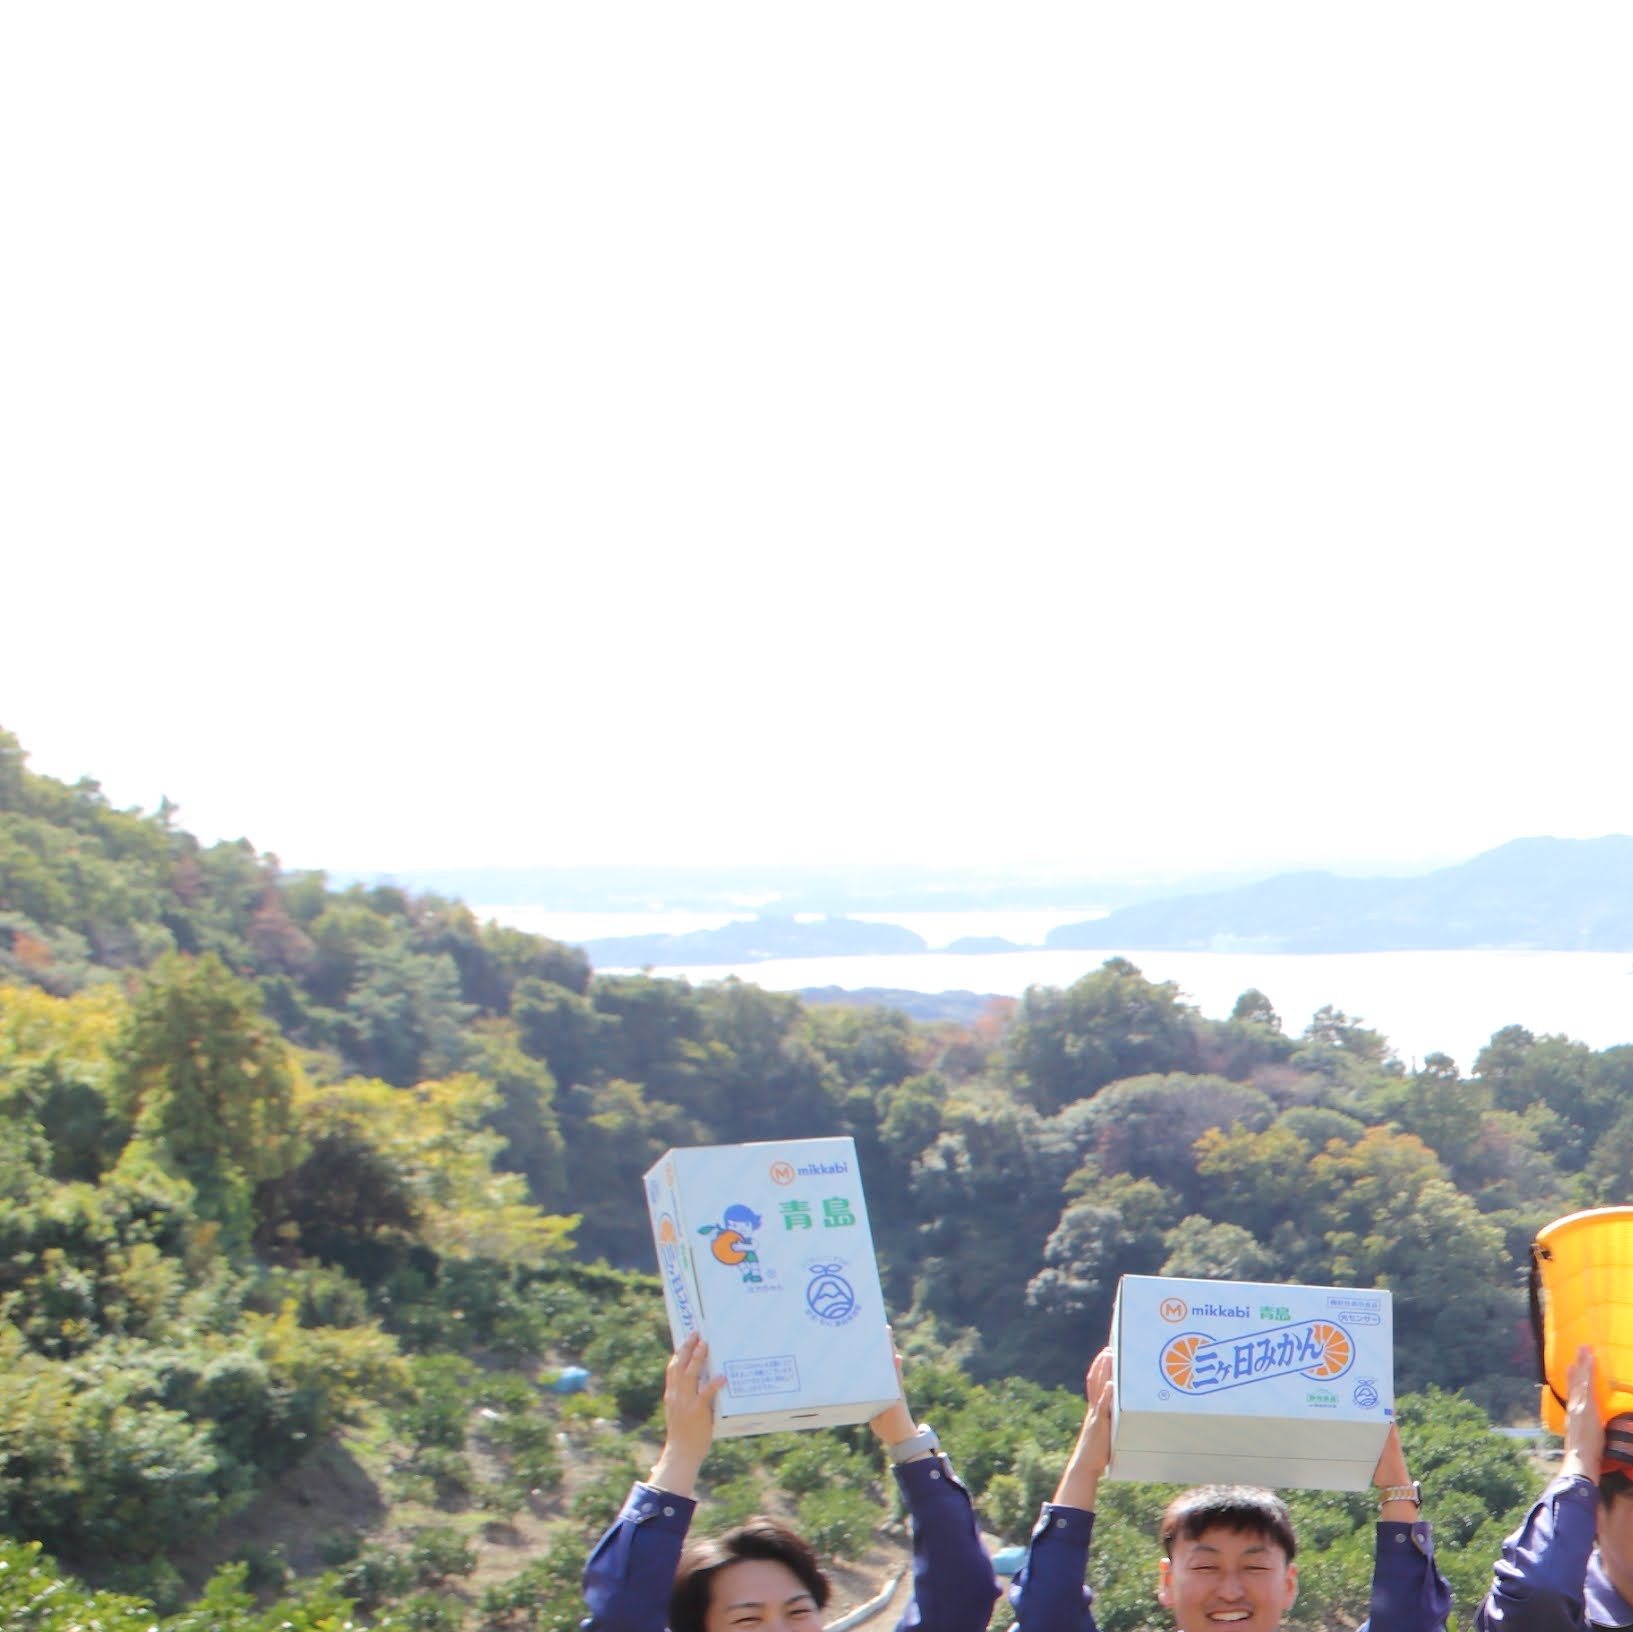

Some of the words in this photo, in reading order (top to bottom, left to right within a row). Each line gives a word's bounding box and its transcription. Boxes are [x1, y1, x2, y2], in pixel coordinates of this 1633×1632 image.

[797, 1162, 848, 1177] mikkabi
[778, 1196, 856, 1231] 青島
[1191, 1304, 1251, 1319] mikkabi
[1259, 1305, 1292, 1321] 青島
[1192, 1327, 1325, 1389] 三ヶ日みかん
